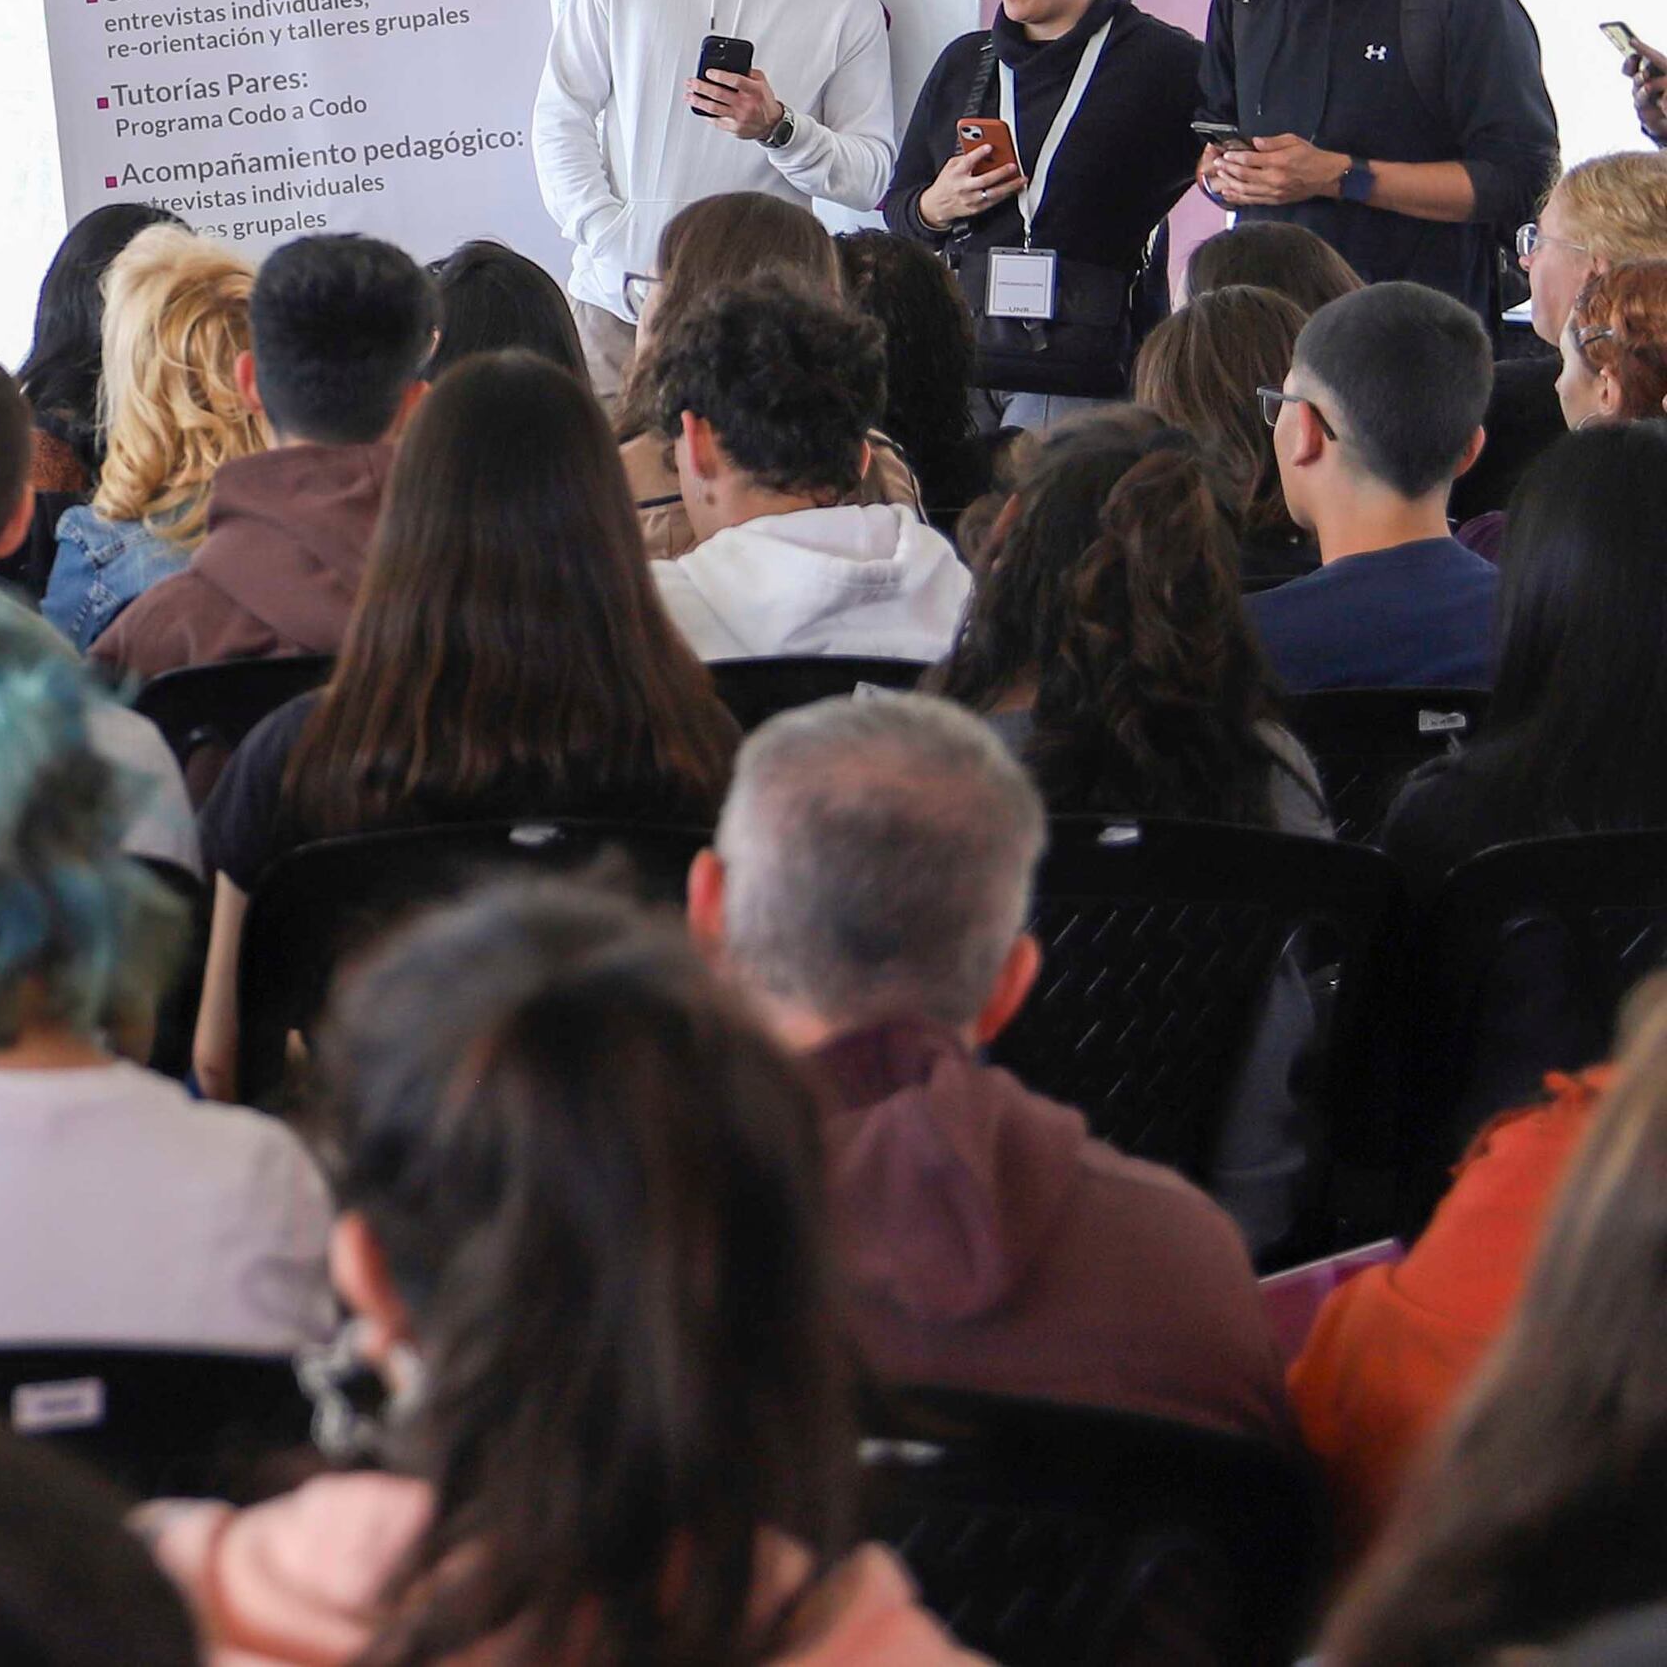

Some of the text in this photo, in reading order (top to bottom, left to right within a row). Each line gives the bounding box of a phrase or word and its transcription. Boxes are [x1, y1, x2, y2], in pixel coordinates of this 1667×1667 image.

[104, 1, 227, 33] entrevistas
[107, 6, 470, 59] re-orientación y talleres grupales
[111, 70, 310, 108] Tutorías Pares:
[115, 94, 368, 139] Programa Codo a Codo
[121, 127, 525, 187] Acompañamiento pedagógico:
[251, 173, 386, 204] individuales
[233, 210, 328, 239] grupales
